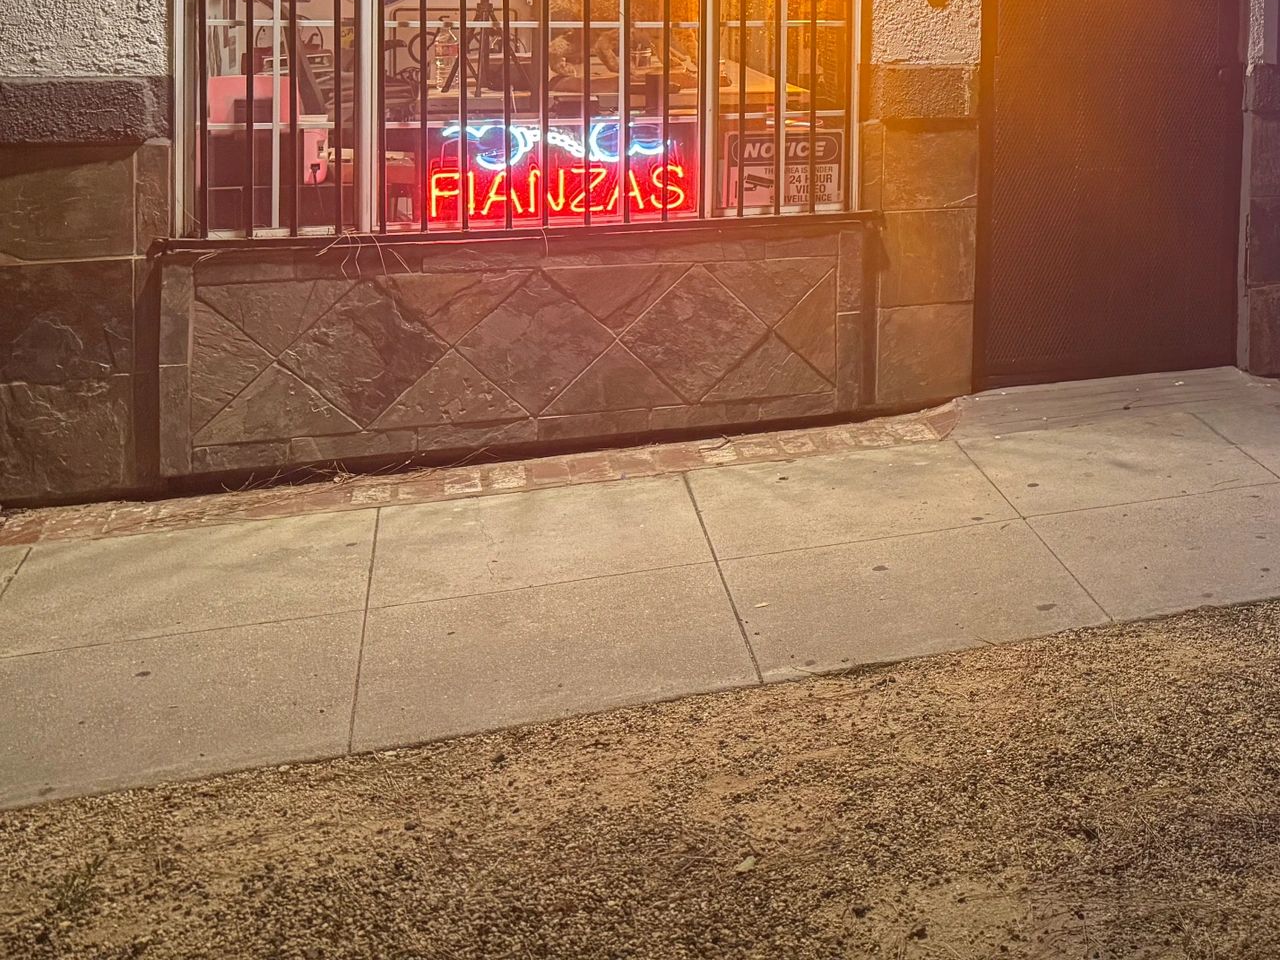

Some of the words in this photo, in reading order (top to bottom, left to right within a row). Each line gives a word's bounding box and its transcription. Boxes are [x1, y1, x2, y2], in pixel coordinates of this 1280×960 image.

[743, 141, 827, 159] NOICE
[764, 167, 779, 175] TH
[789, 174, 802, 185] 24
[431, 164, 687, 218] FIANZAS
